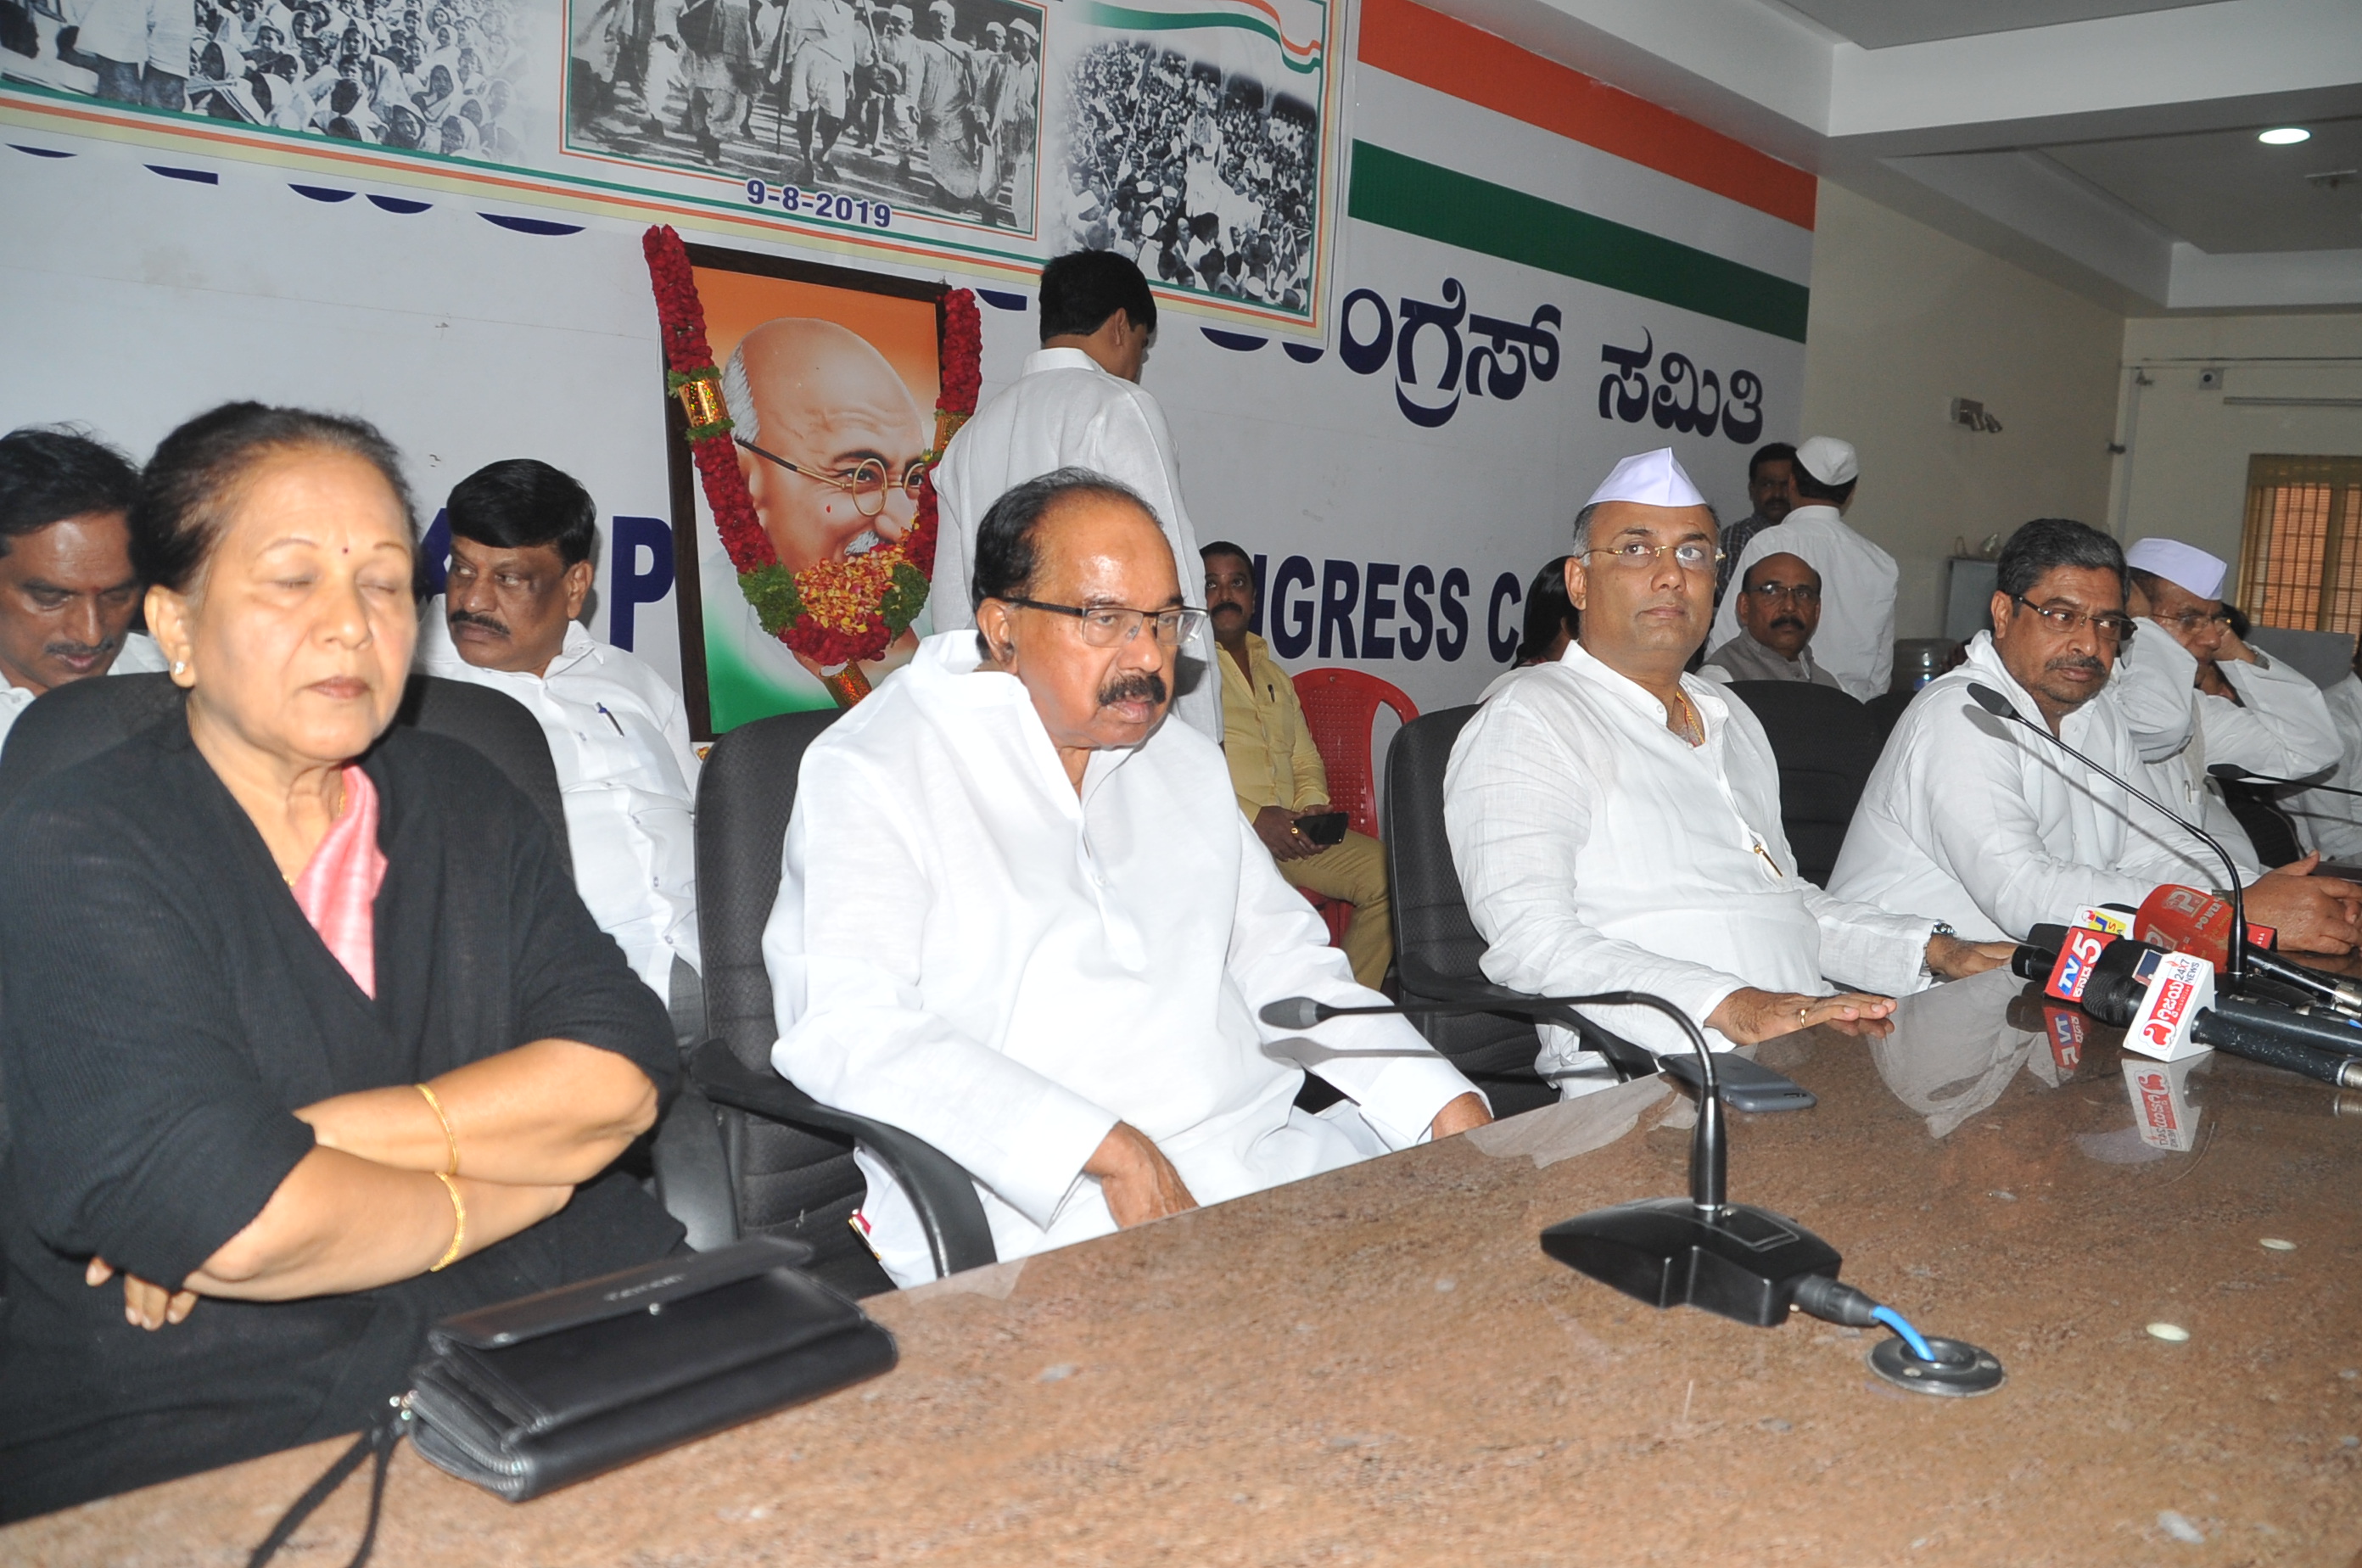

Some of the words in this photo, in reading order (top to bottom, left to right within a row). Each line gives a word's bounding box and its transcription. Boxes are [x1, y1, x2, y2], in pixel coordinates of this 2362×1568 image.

[747, 180, 891, 227] 9-8-2019
[1598, 325, 1764, 444] ಸಮಿತಿ
[2194, 902, 2223, 931] POWER
[2174, 958, 2190, 981] 24X7
[2185, 961, 2200, 983] NEWS
